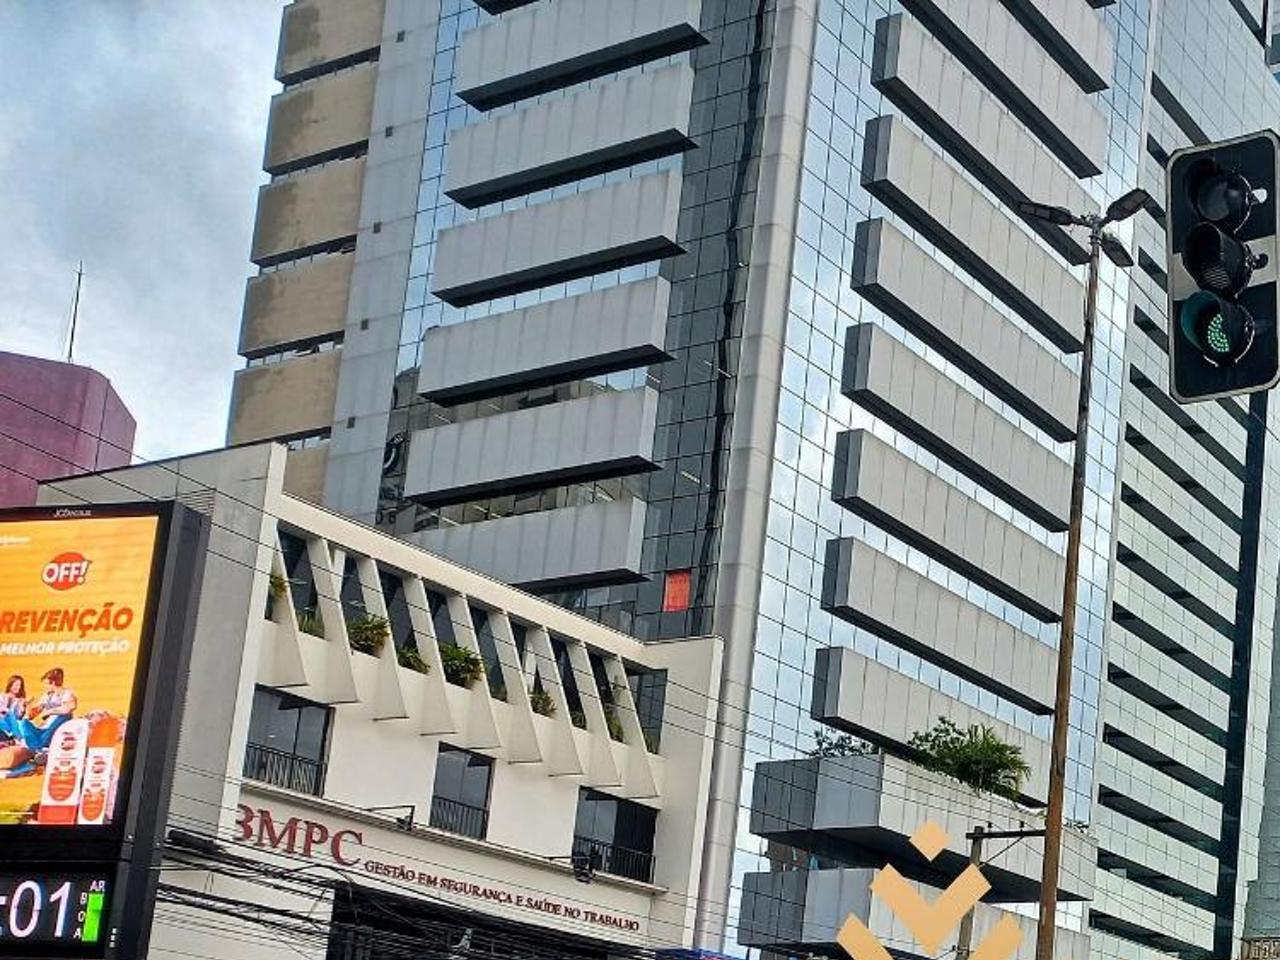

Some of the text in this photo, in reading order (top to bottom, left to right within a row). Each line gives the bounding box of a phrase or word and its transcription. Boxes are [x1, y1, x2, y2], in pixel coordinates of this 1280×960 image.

[42, 560, 91, 585] OFF!
[0, 602, 134, 638] REVENÇÃO
[364, 860, 640, 931] GESTÃO EM SEGURANÇA E SAÚDE NO TRABALHO
